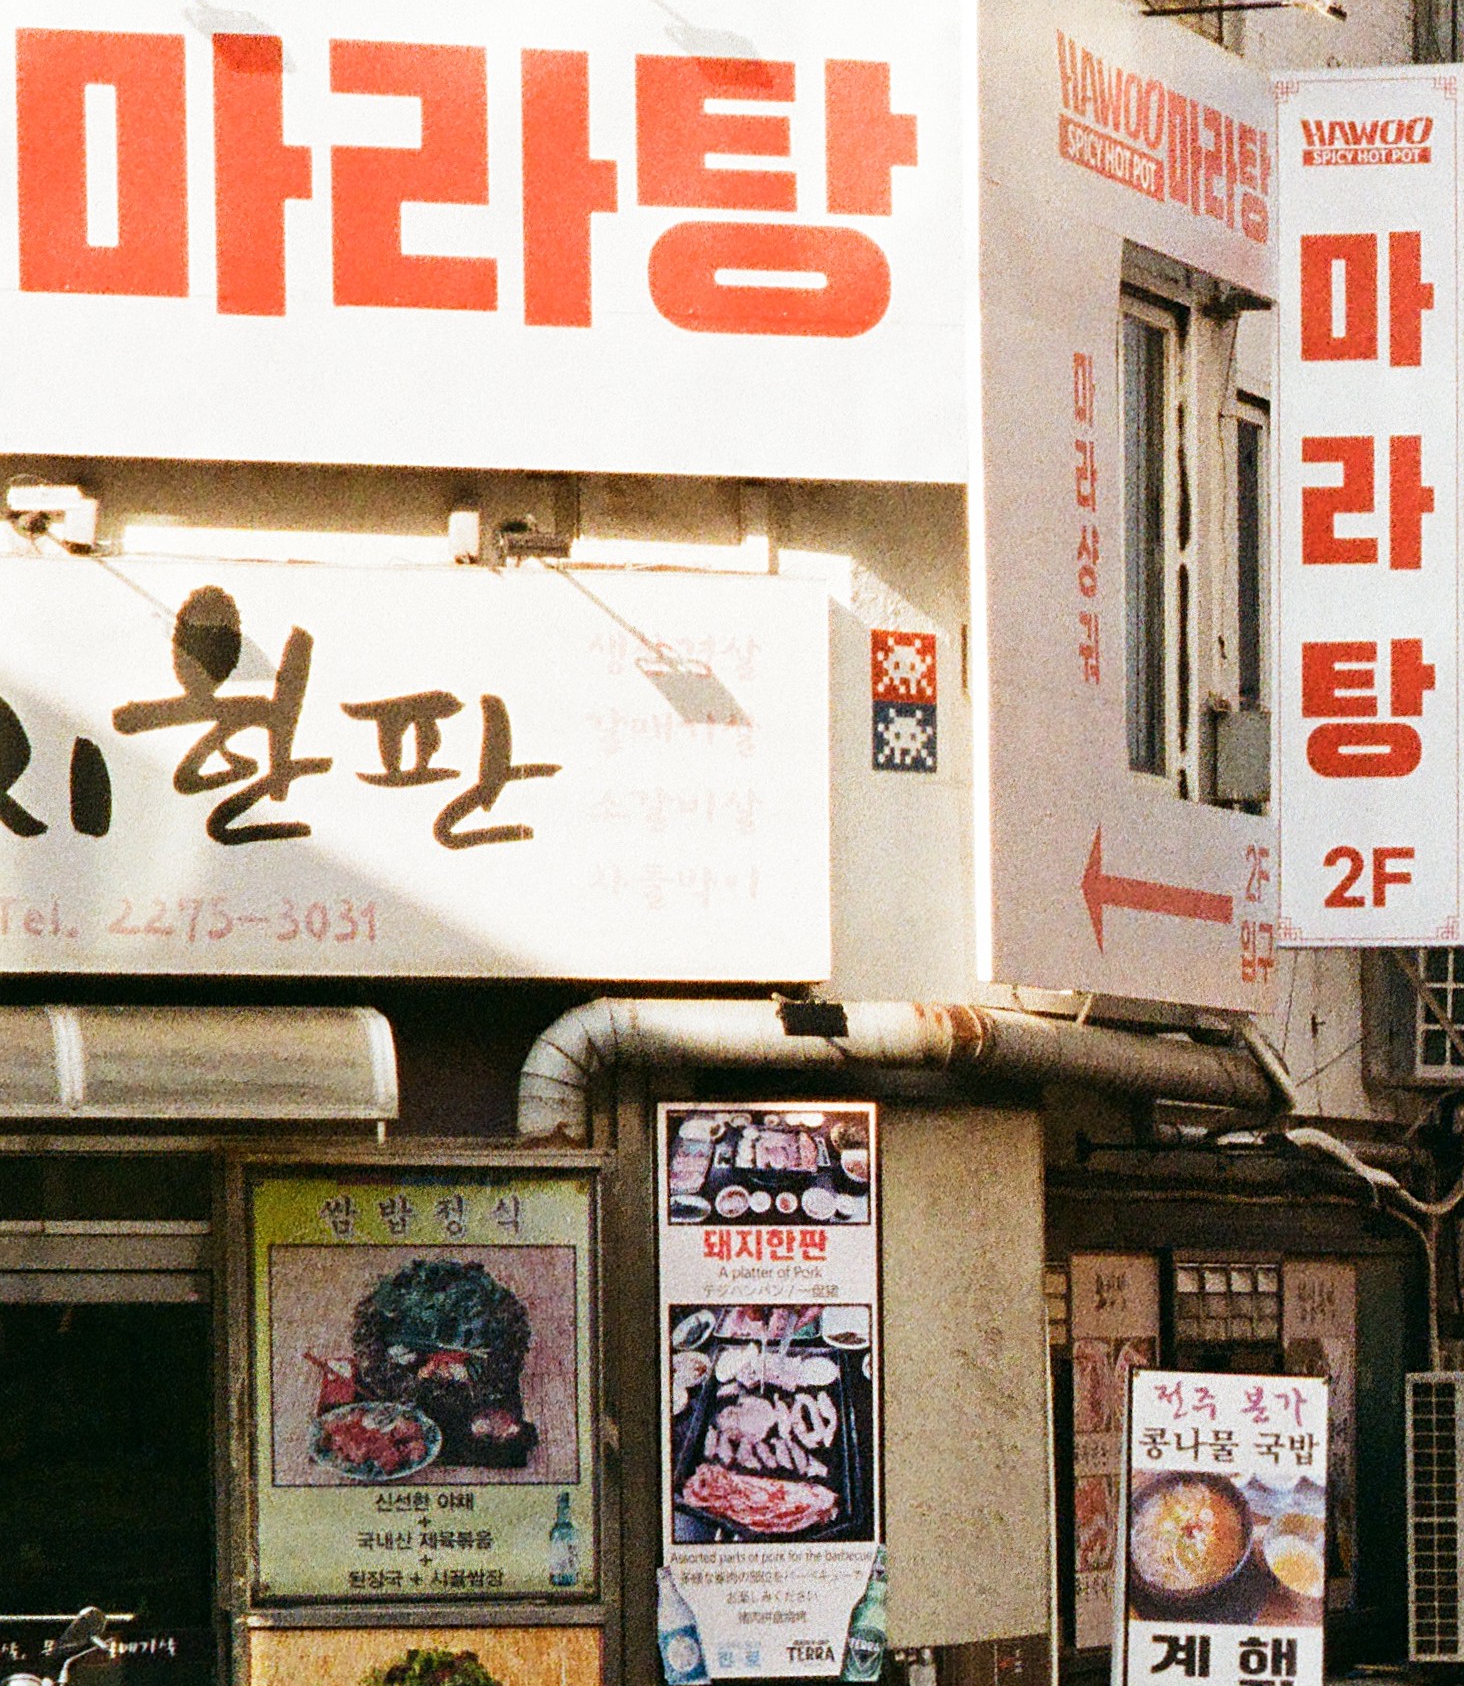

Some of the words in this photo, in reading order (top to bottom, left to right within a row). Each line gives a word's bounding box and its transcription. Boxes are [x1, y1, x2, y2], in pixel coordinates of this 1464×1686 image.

[1057, 27, 1165, 150] HAWOO
[1301, 116, 1434, 147] HAWOO
[1167, 89, 1271, 244] 마라탕
[1313, 150, 1353, 164] SPICY
[1357, 149, 1387, 163] HOT
[1391, 148, 1422, 162] POT
[15, 27, 918, 339] 마라탕
[1301, 230, 1436, 779] 마라탕
[1245, 844, 1271, 902] 2F
[1323, 845, 1415, 908] 2F
[107, 895, 377, 942] 2275-3031
[1240, 920, 1275, 984] 입구
[318, 1193, 521, 1238] 쌈밥정식
[703, 1228, 828, 1262] 돼지한판
[732, 1265, 773, 1281] platter
[793, 1265, 823, 1278] Pork
[1137, 1425, 1240, 1464] 콩나물
[1254, 1429, 1321, 1466] 국밥
[785, 1646, 836, 1662] TERRA
